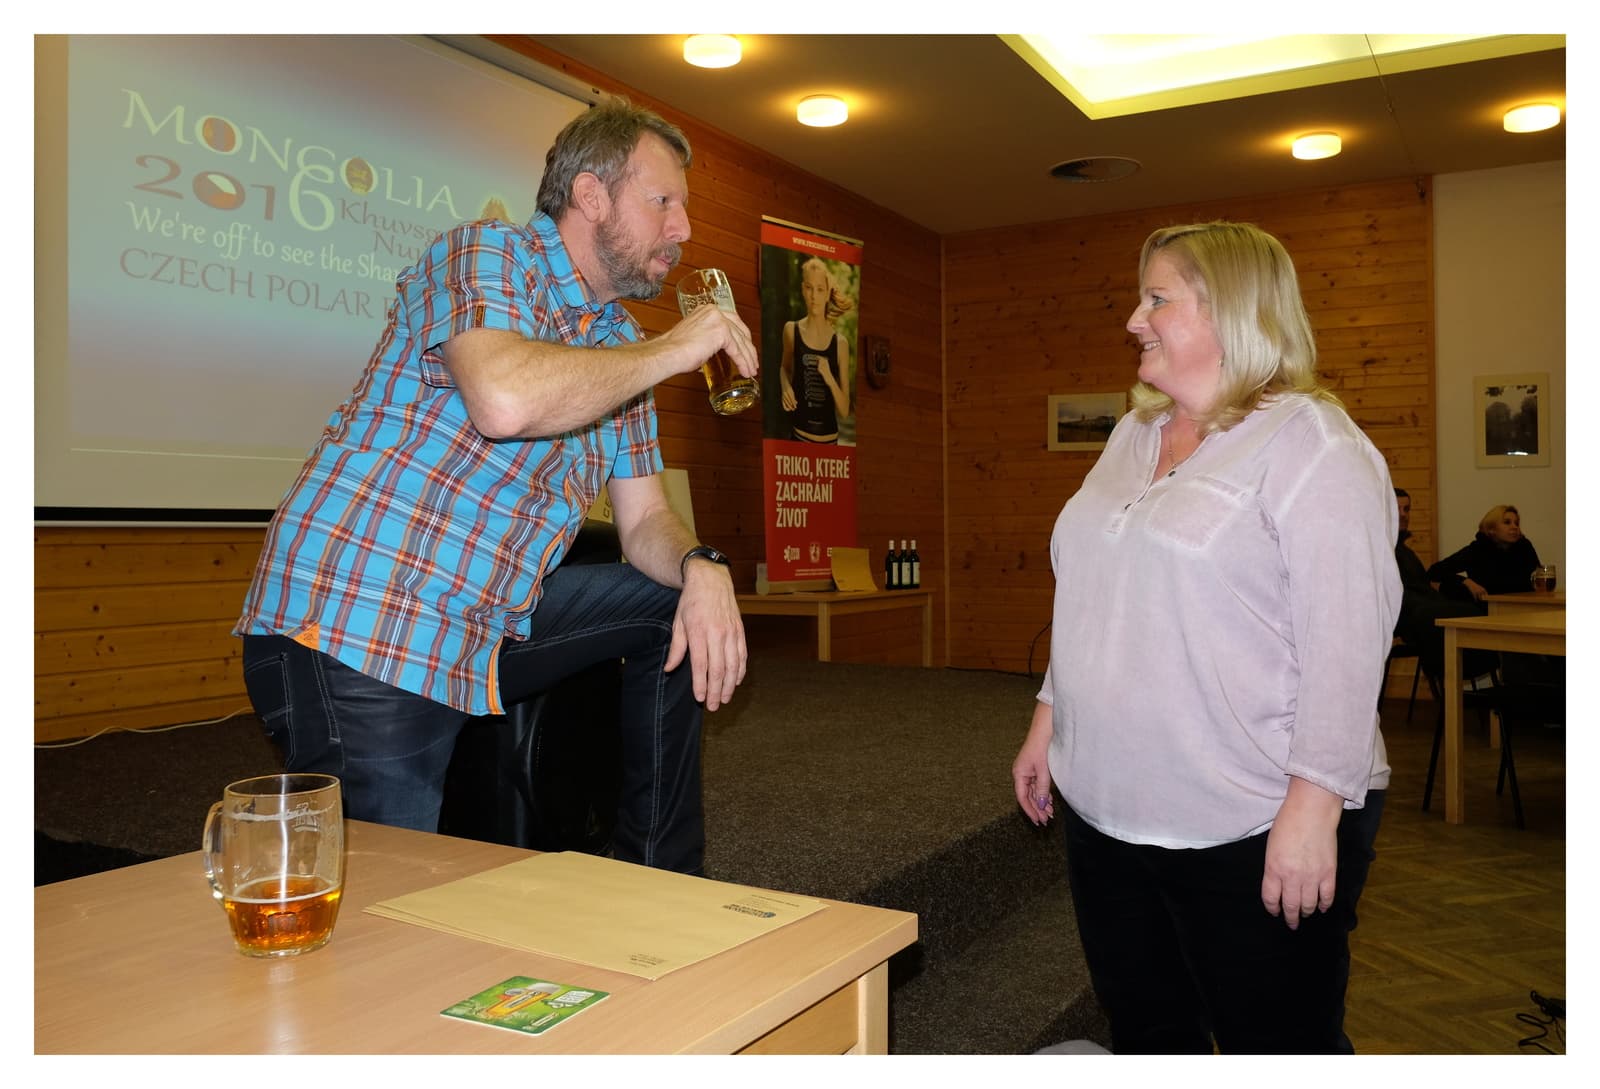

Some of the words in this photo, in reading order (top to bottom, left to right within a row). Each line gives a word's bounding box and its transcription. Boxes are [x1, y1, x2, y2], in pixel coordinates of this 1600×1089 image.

[121, 88, 463, 220] MONGOLIA
[133, 154, 335, 232] 2016
[123, 200, 207, 244] We're
[213, 221, 251, 260] off
[253, 231, 275, 258] to
[281, 245, 315, 267] see
[320, 243, 353, 275] the
[119, 247, 256, 299] CZECH
[265, 274, 374, 319] POLAR
[775, 454, 814, 481] TRIKO,
[816, 455, 850, 479] KTERÉ
[775, 478, 833, 503] ZACHRÁNÍ
[775, 501, 808, 528] ŽIVOT
